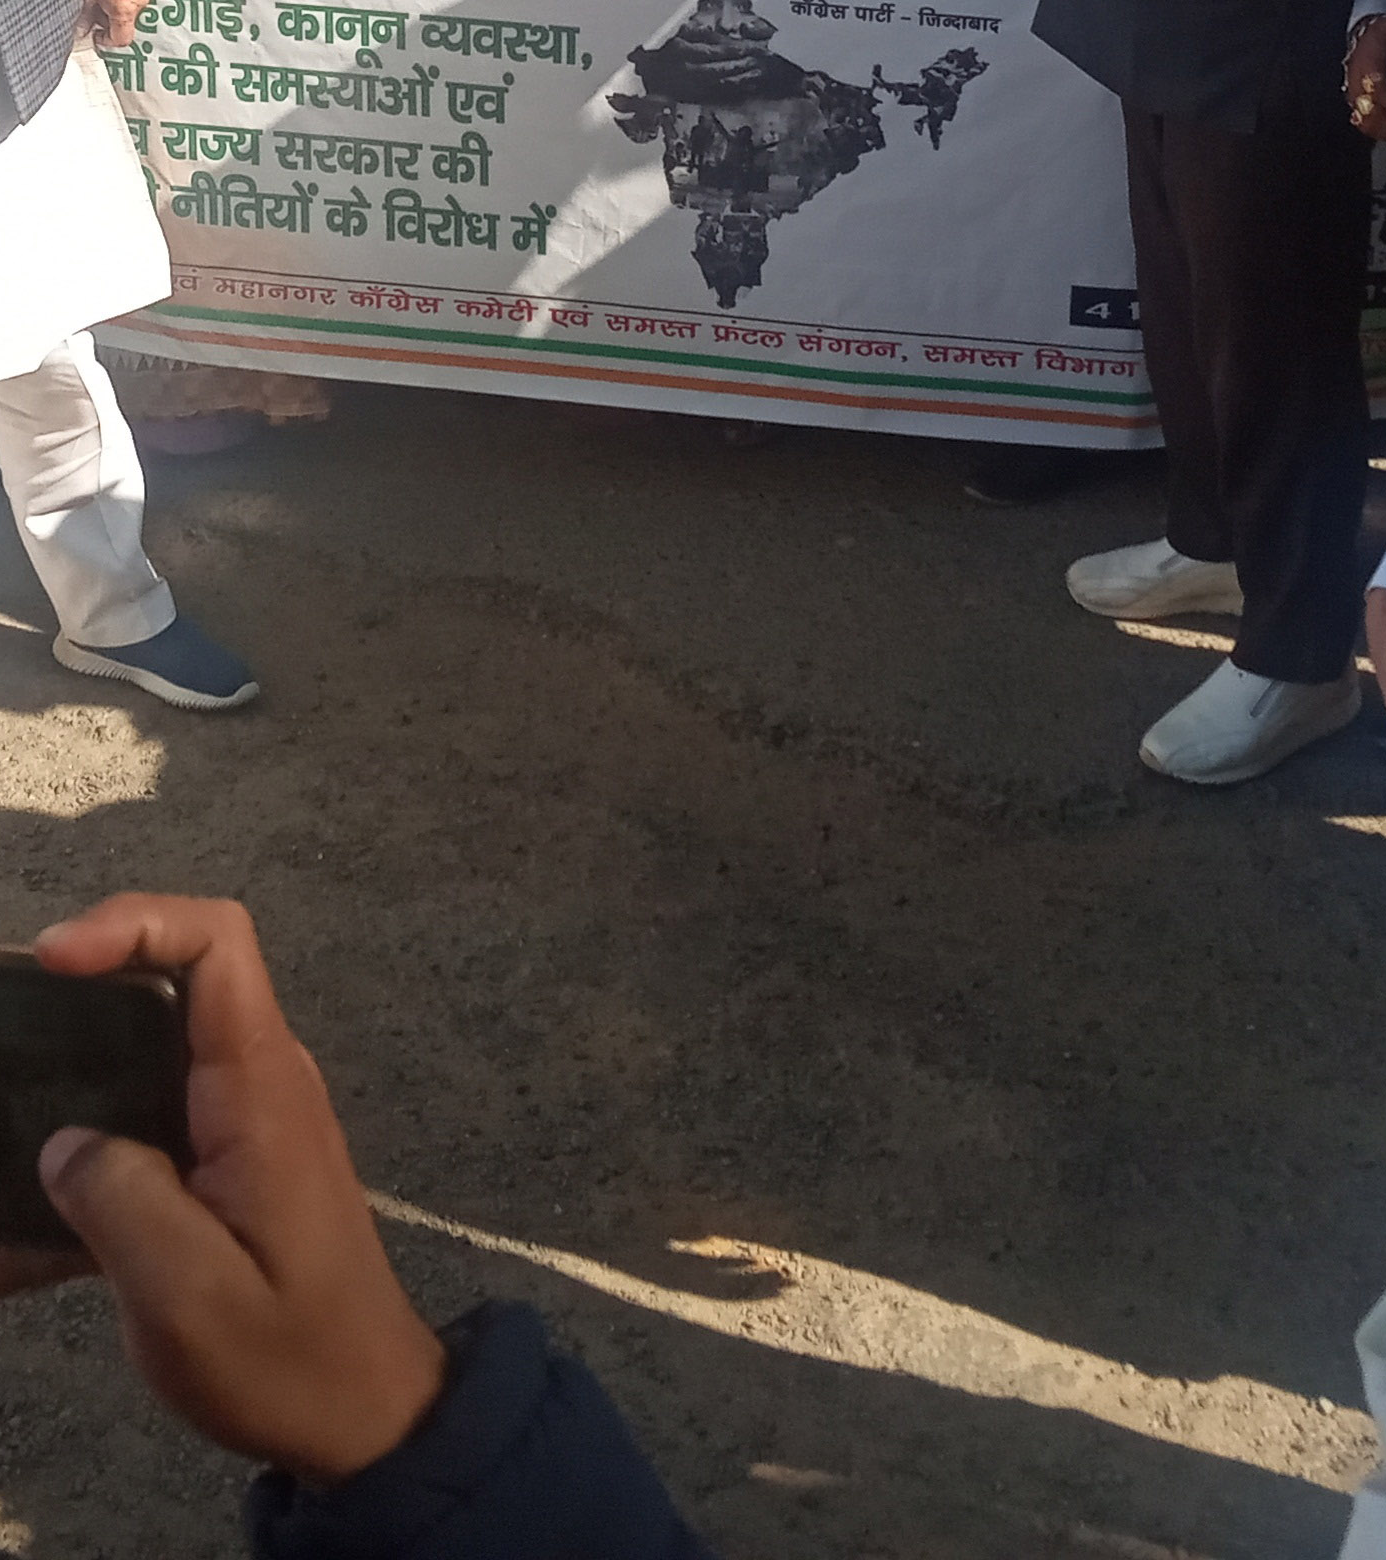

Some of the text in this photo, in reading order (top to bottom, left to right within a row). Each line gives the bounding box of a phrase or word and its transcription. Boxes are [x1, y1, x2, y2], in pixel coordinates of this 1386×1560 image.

[275, 1, 410, 68] कानून
[419, 13, 592, 70] व्यवस्था,
[854, 2, 896, 24] पार्टी
[918, 6, 1002, 34] जिन्दाबाद
[158, 42, 220, 99] की
[230, 62, 441, 117] समस्याओं
[445, 72, 515, 125] एवं
[160, 121, 263, 166] राज्य
[273, 130, 422, 181] सरकार
[431, 131, 492, 187] की
[170, 172, 319, 233] नीतियों
[323, 187, 373, 238] के
[382, 188, 500, 252] विरोध
[510, 202, 557, 255] में
[214, 275, 337, 306] महानगर
[349, 284, 444, 317] काँग्रेस
[454, 296, 540, 324] कमेटी
[548, 303, 592, 329] एवं
[605, 312, 701, 341] समस्त
[712, 318, 785, 350] फ्रंटल
[796, 327, 909, 364] संगठन,
[922, 343, 1021, 371] समस्त
[1035, 347, 1140, 379] विभाग
